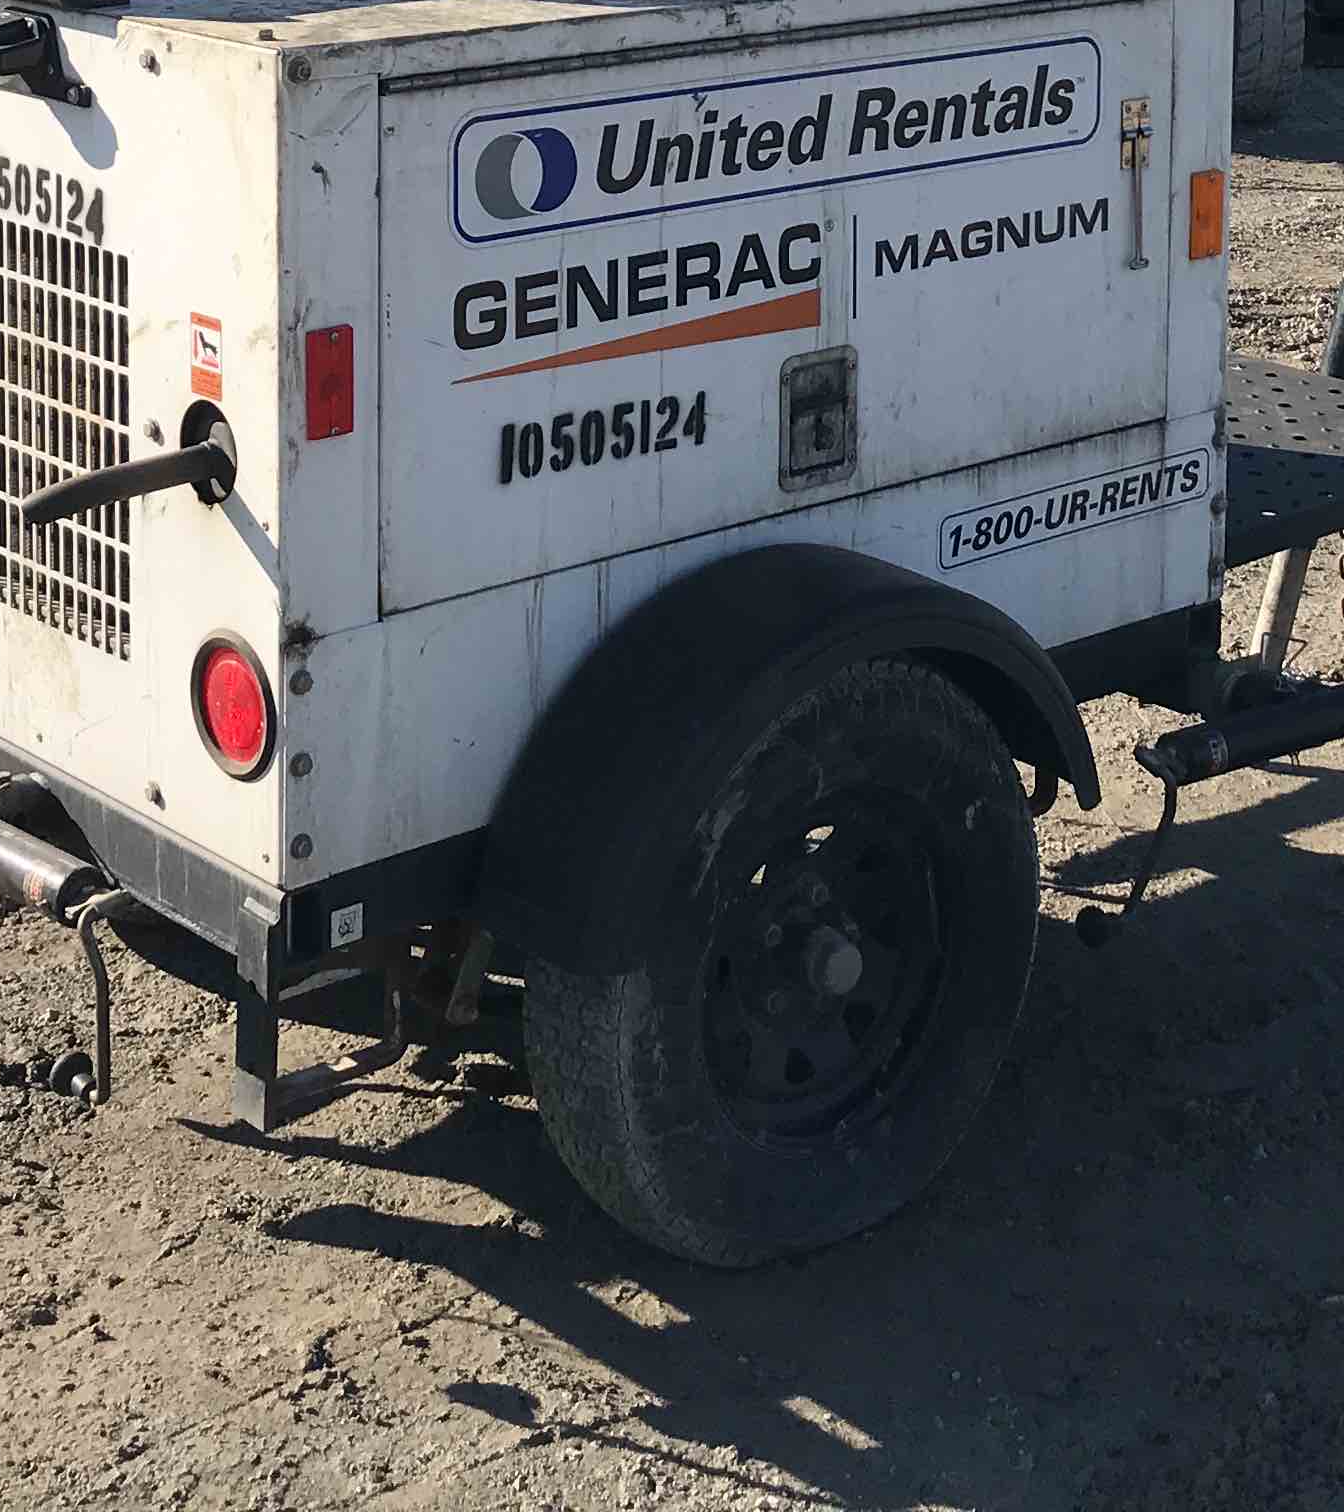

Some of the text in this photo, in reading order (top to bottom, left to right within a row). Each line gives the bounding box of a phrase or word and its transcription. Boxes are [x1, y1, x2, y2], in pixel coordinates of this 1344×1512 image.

[596, 63, 1076, 195] United Rentals
[452, 222, 822, 352] GENERAC
[874, 197, 1109, 278] MAGNUM
[499, 390, 706, 485] 10505124
[948, 459, 1201, 558] 1-800-UR-RENTS
